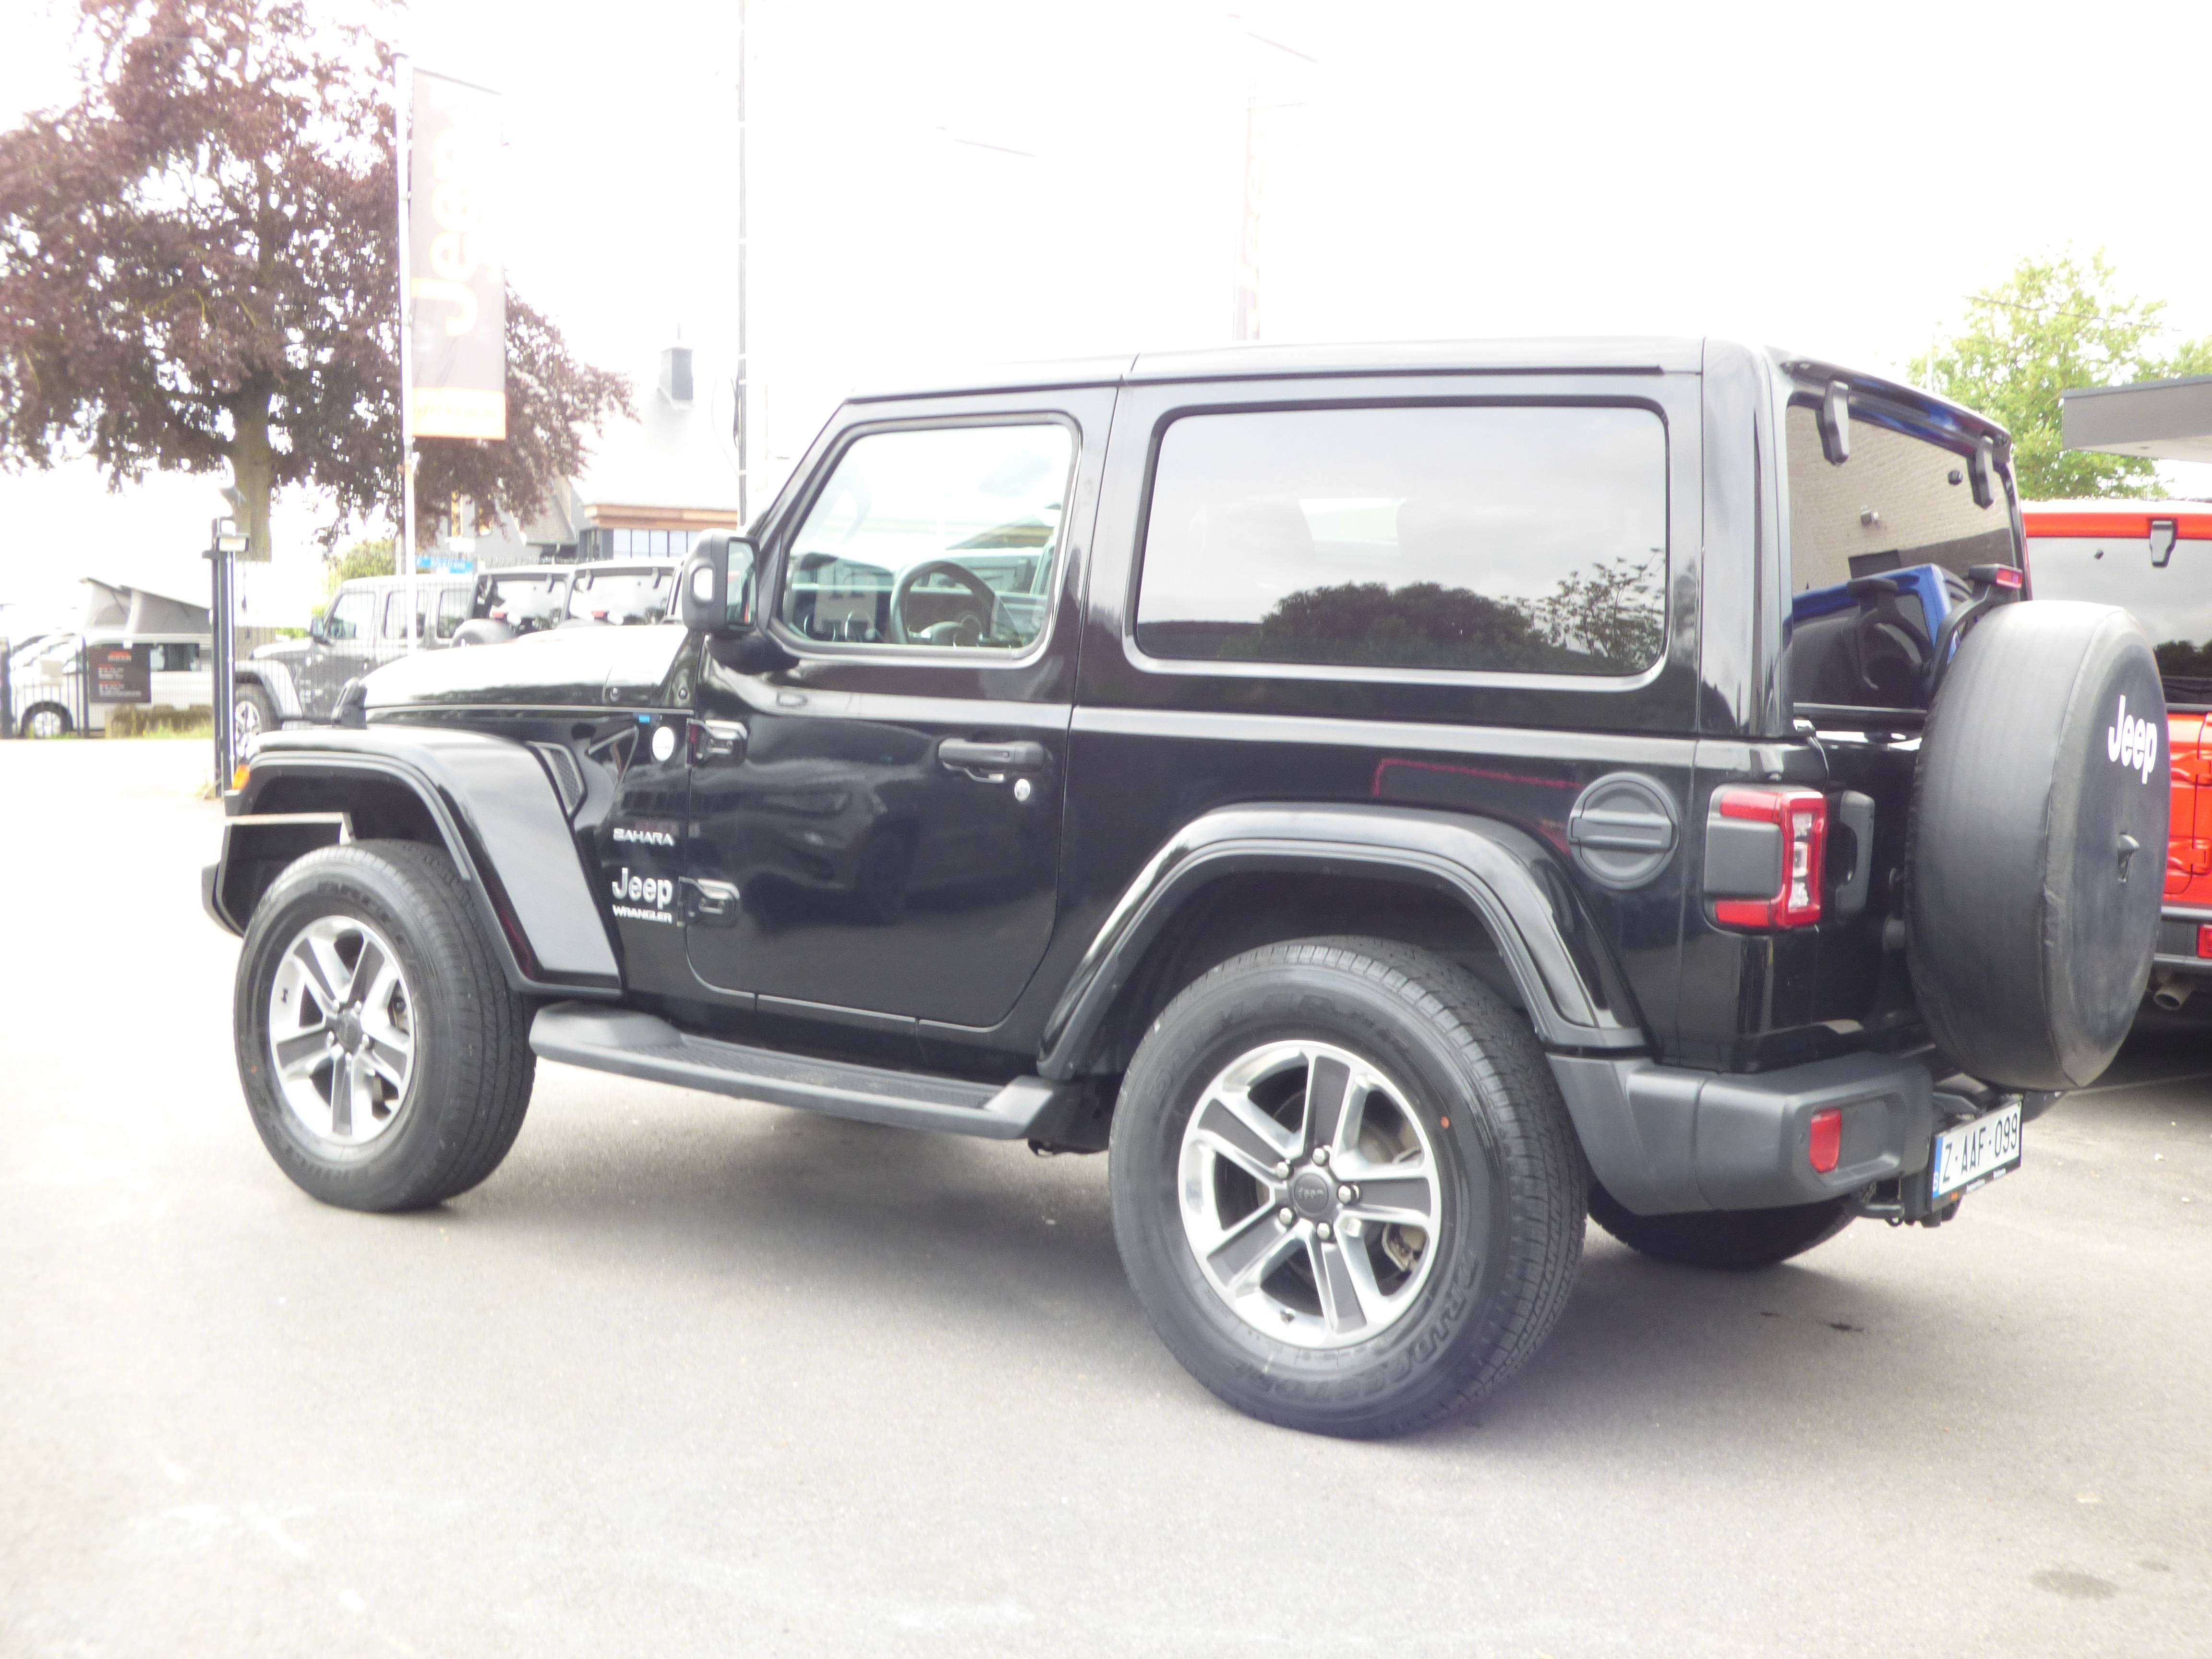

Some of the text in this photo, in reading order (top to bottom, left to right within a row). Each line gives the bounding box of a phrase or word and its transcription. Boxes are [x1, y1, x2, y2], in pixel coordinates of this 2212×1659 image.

[2108, 694, 2157, 785] Jeep
[613, 828, 675, 846] SAHARA
[612, 867, 672, 910] Jeep
